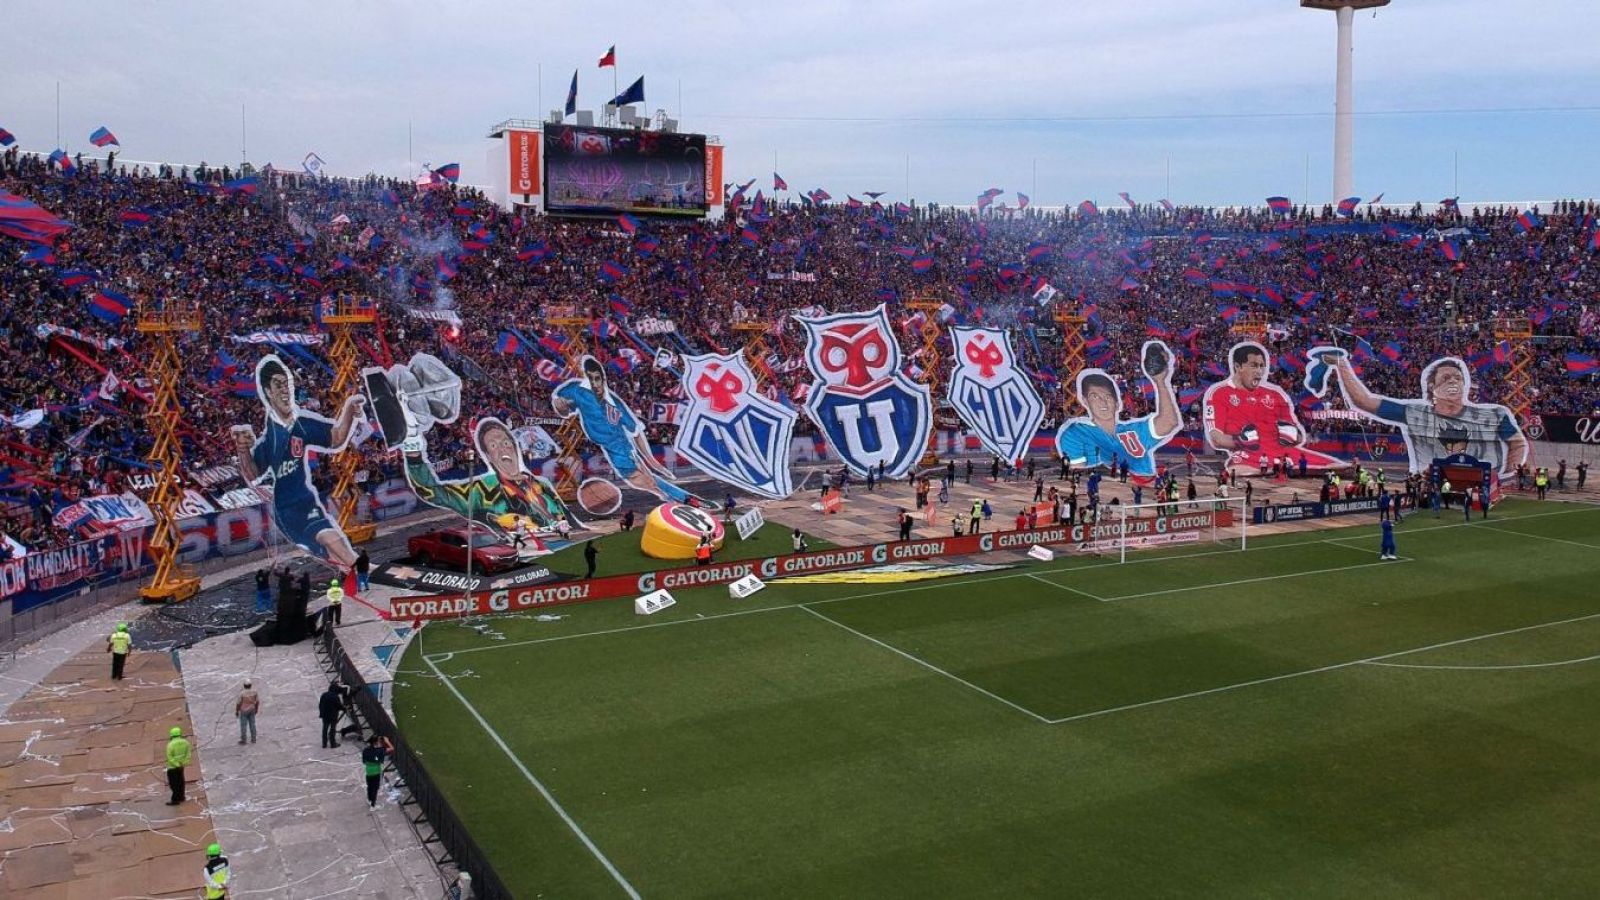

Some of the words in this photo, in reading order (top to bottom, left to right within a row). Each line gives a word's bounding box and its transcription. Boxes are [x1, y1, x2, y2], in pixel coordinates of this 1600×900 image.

[521, 134, 529, 178] GATORADE
[834, 399, 898, 463] U
[998, 530, 1066, 547] GATORADE
[784, 550, 865, 572] GATORADE
[421, 572, 480, 590] COLORADO
[515, 568, 550, 583] COLORADO
[663, 564, 753, 587] GATORADE
